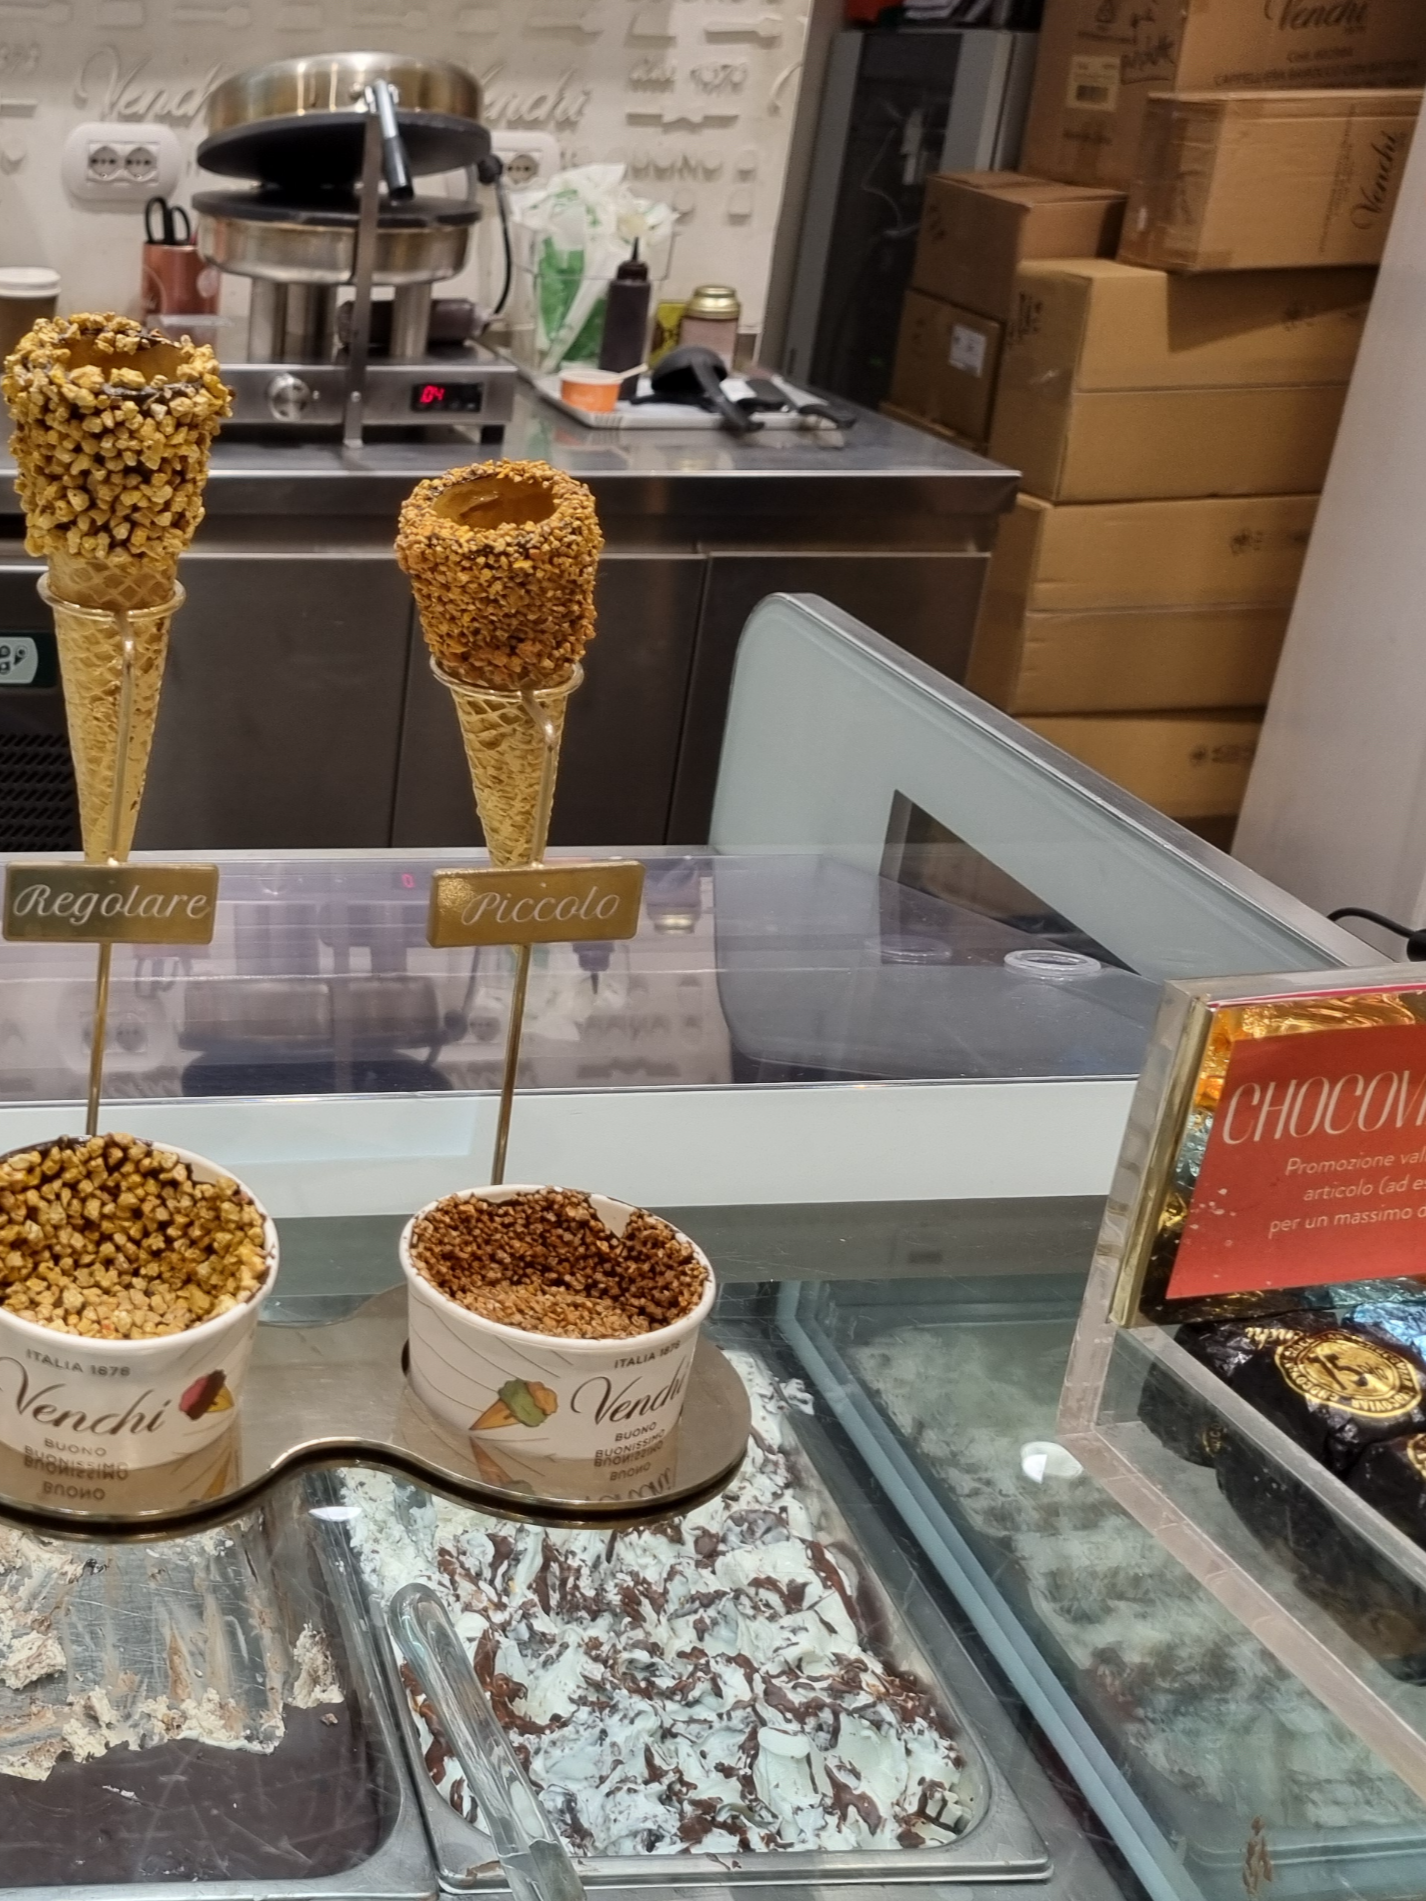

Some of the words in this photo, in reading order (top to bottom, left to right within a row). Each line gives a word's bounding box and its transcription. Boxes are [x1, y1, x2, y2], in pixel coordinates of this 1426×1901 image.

[471, 62, 590, 124] enchi
[1349, 128, 1398, 230] Venchi
[11, 882, 208, 925] Regolare
[461, 887, 623, 926] Piccolo
[1285, 1152, 1395, 1176] Promozione
[1303, 1179, 1375, 1201] articolo
[1379, 1174, 1411, 1196] (ad
[1268, 1218, 1301, 1239] per
[1305, 1216, 1328, 1228] un
[1333, 1204, 1413, 1225] massimo
[26, 1348, 83, 1373] ITALIA
[92, 1365, 131, 1377] 1878
[614, 1352, 656, 1369] ITALIA
[572, 1355, 686, 1425] Venchi
[595, 1429, 665, 1458] BUONISSIMO
[615, 1422, 657, 1441] BUONO
[44, 1438, 108, 1457] BUONO
